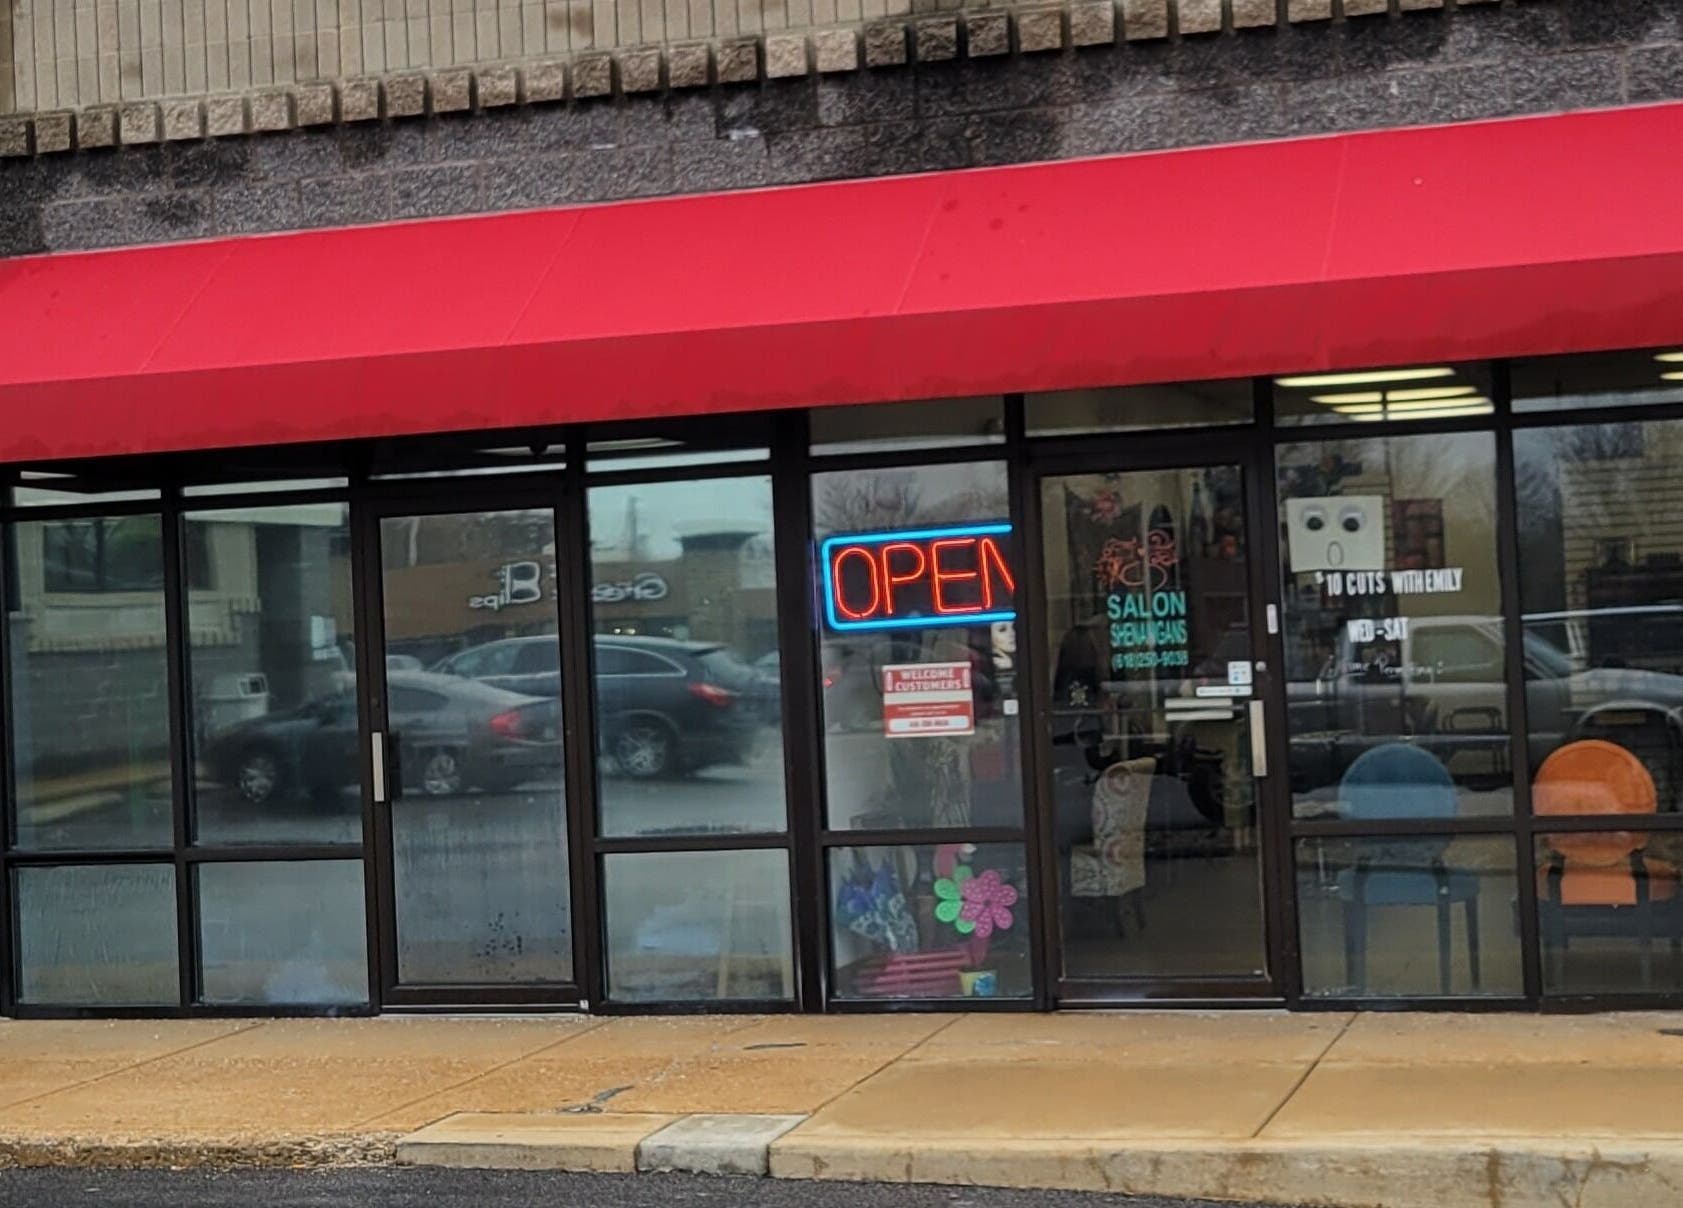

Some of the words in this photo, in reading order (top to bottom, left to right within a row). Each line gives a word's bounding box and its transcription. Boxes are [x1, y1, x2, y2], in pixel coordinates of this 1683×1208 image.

[834, 538, 1015, 619] OPEN
[1346, 572, 1386, 596] CUTS
[1391, 570, 1425, 594] WITH
[1425, 568, 1463, 592] EMILY
[1107, 591, 1186, 619] SALON
[895, 680, 961, 691] CUSTOMERS
[902, 668, 954, 679] WELCOME
